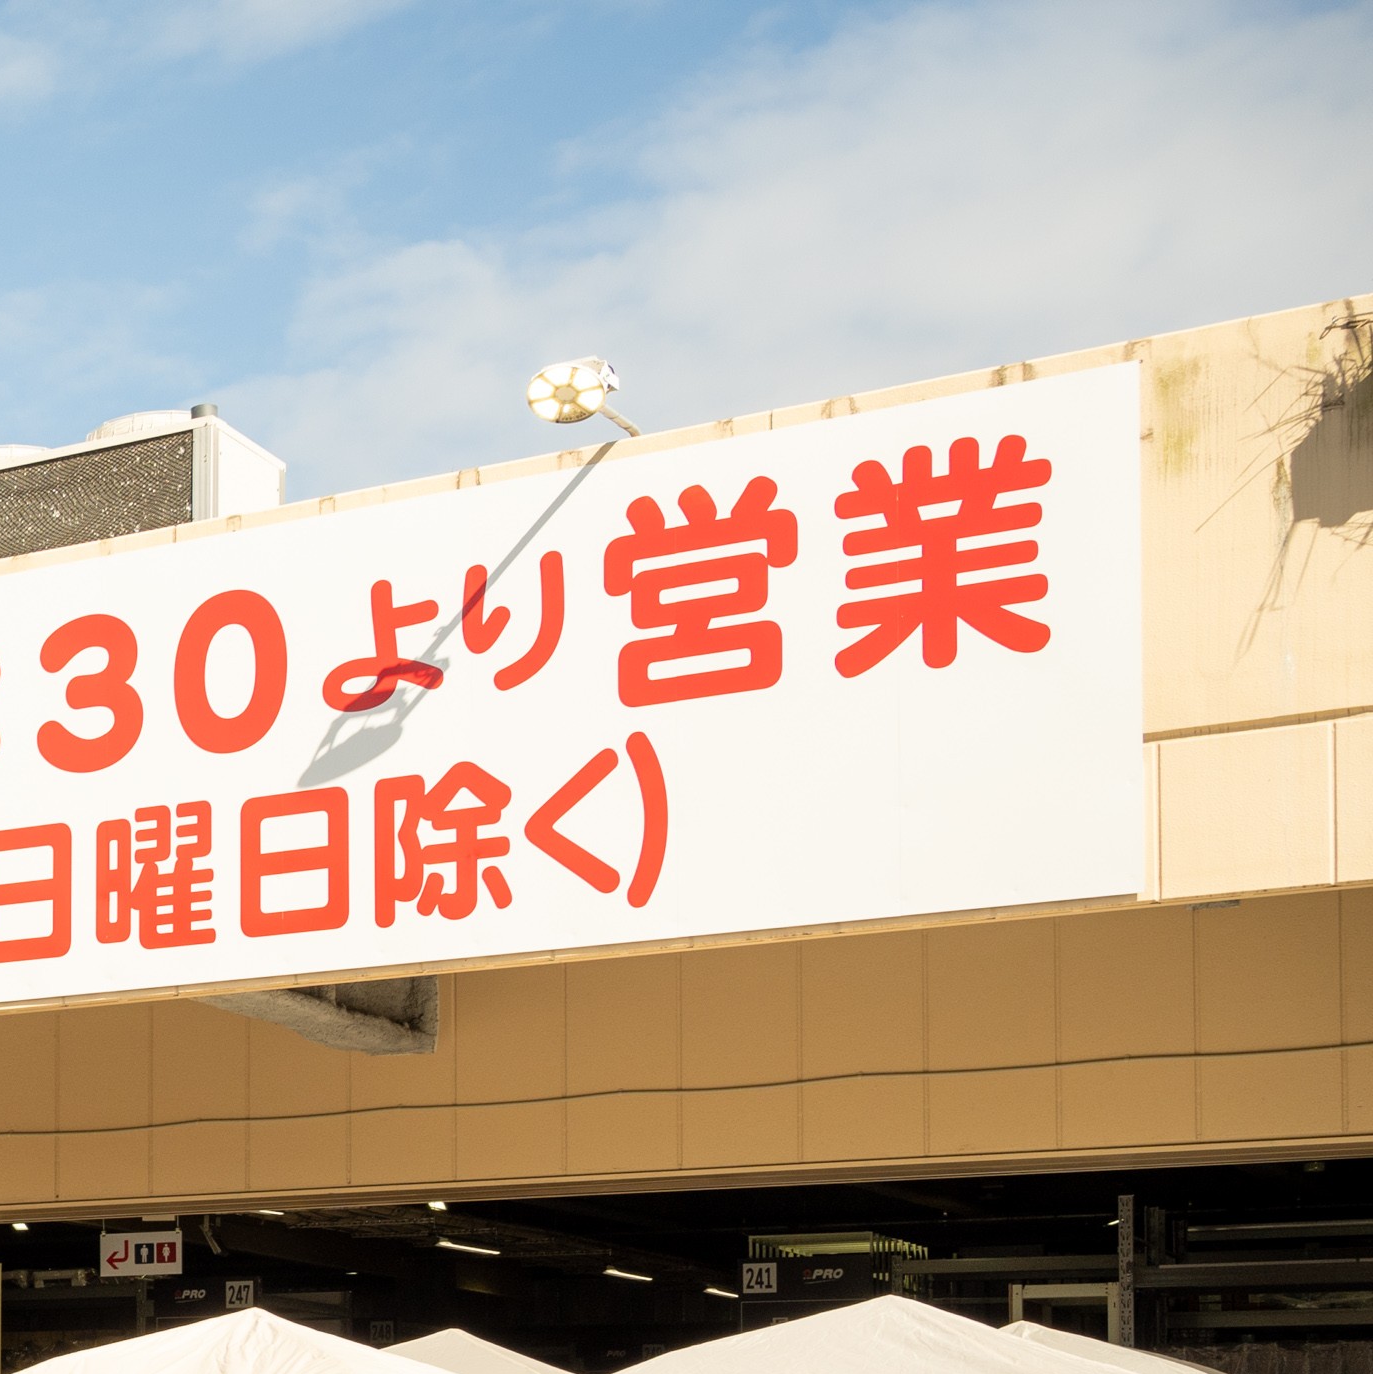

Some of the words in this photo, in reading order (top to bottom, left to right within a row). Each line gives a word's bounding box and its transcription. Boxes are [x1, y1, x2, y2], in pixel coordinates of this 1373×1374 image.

[746, 1267, 773, 1289] 241
[812, 1268, 844, 1279] PRO
[182, 1289, 206, 1299] PRO
[228, 1285, 251, 1305] 247
